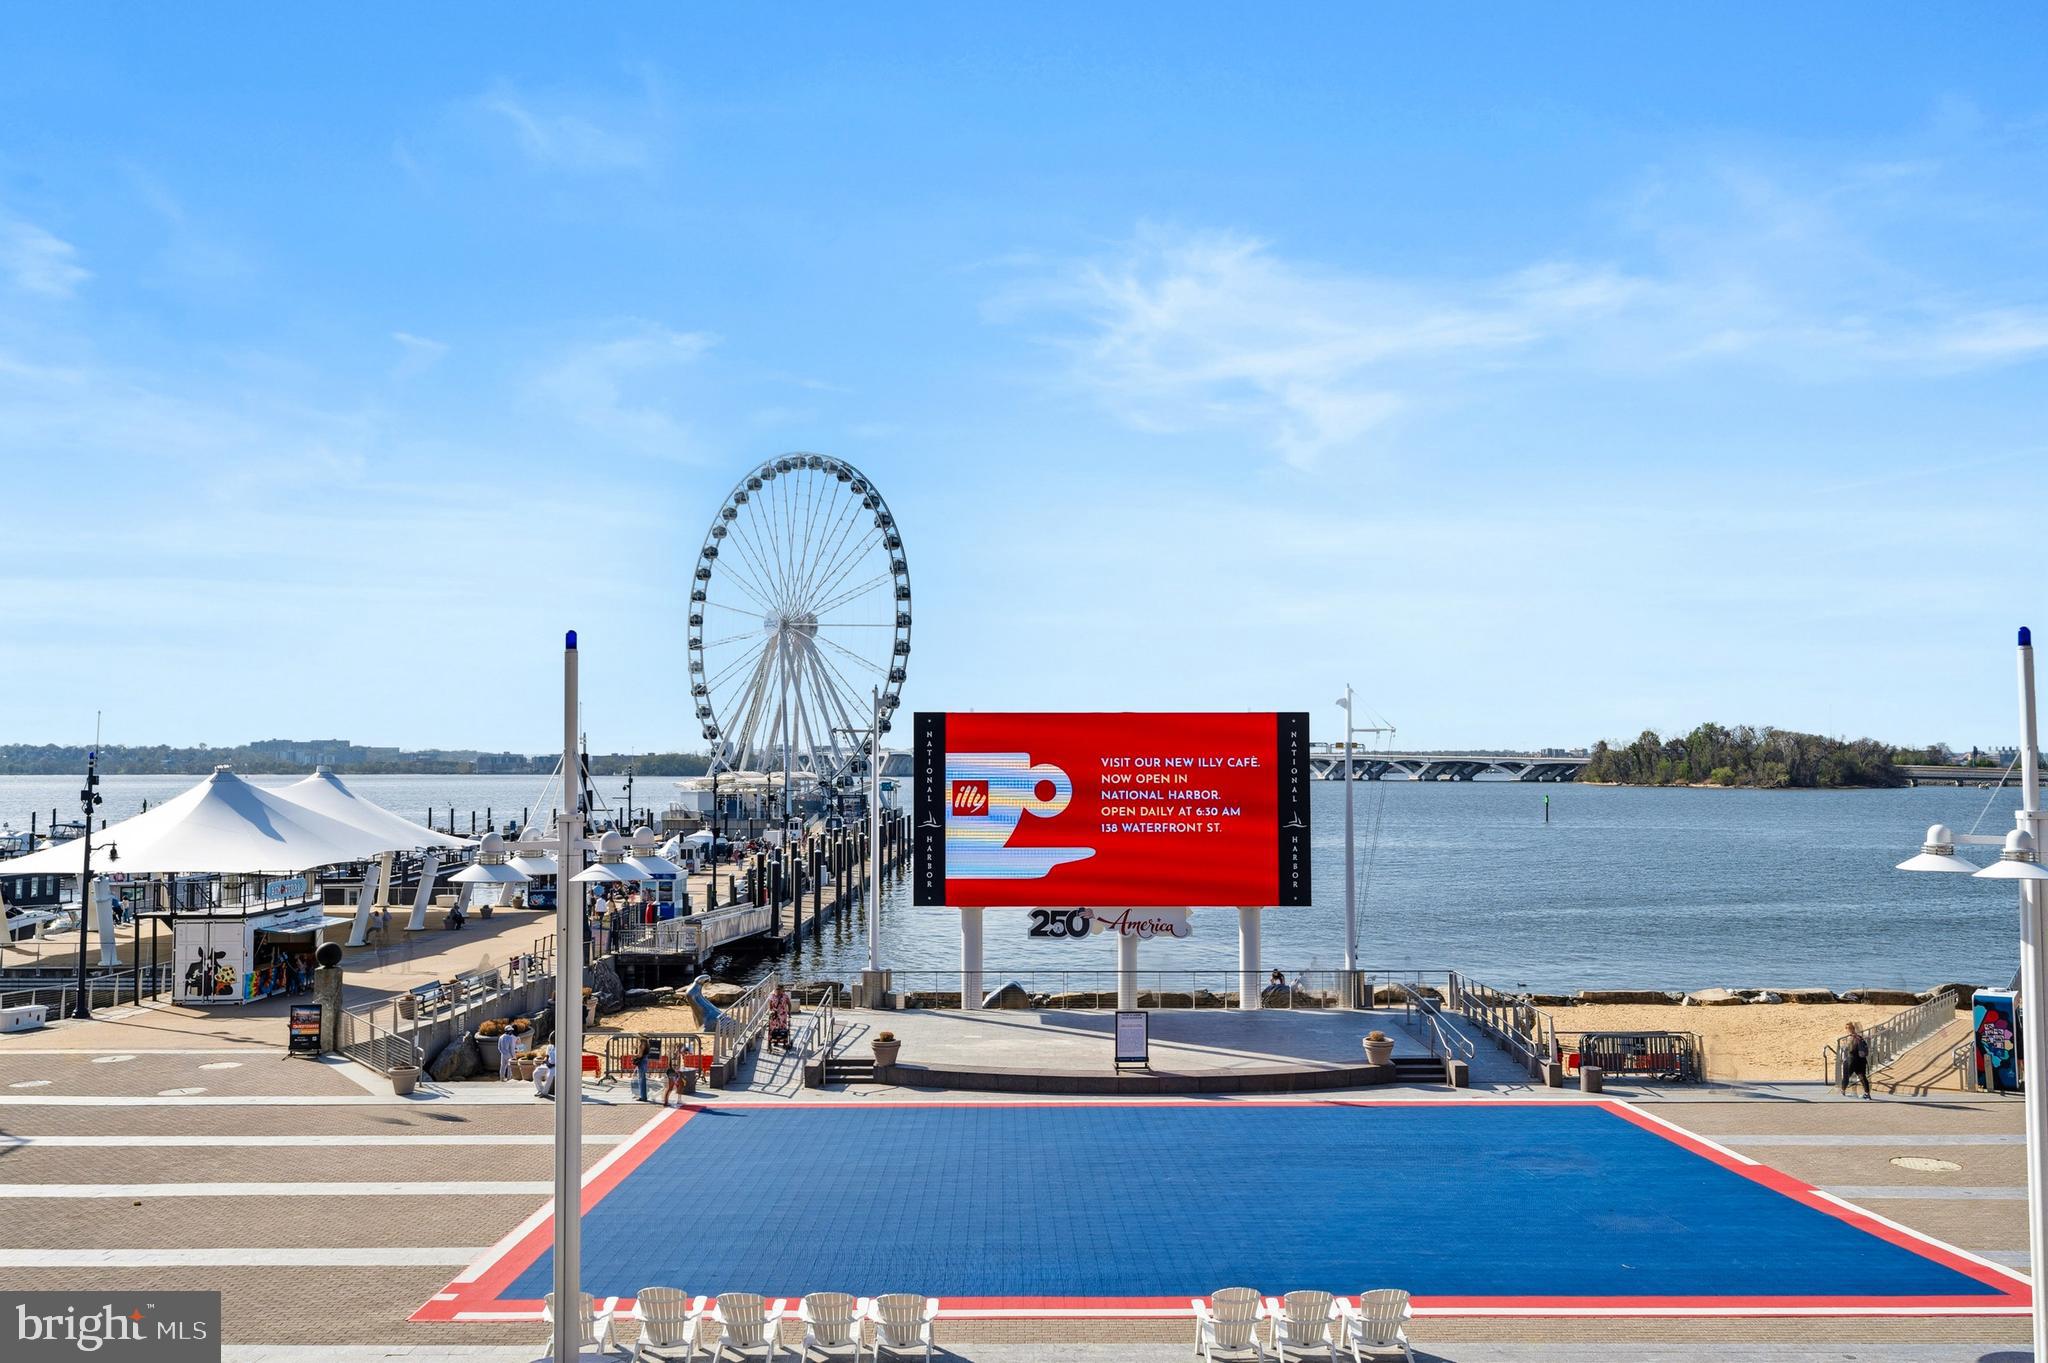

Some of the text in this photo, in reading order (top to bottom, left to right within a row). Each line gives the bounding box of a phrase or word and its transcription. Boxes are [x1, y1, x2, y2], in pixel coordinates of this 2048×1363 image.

[1100, 757, 1131, 768] VISIT
[1134, 757, 1161, 768] OUR
[1165, 757, 1194, 768] NEW
[1198, 757, 1223, 768] ILLY
[1101, 774, 1188, 784] NOW OPEN IN
[954, 784, 987, 813] illy
[1101, 790, 1222, 800] NATIONAL HARBOR.
[1101, 806, 1241, 817] OPEN DAILY AT 6:30 AM
[1101, 822, 1222, 833] 138 WATERFRONT ST.
[1030, 908, 1188, 939] 250 America
